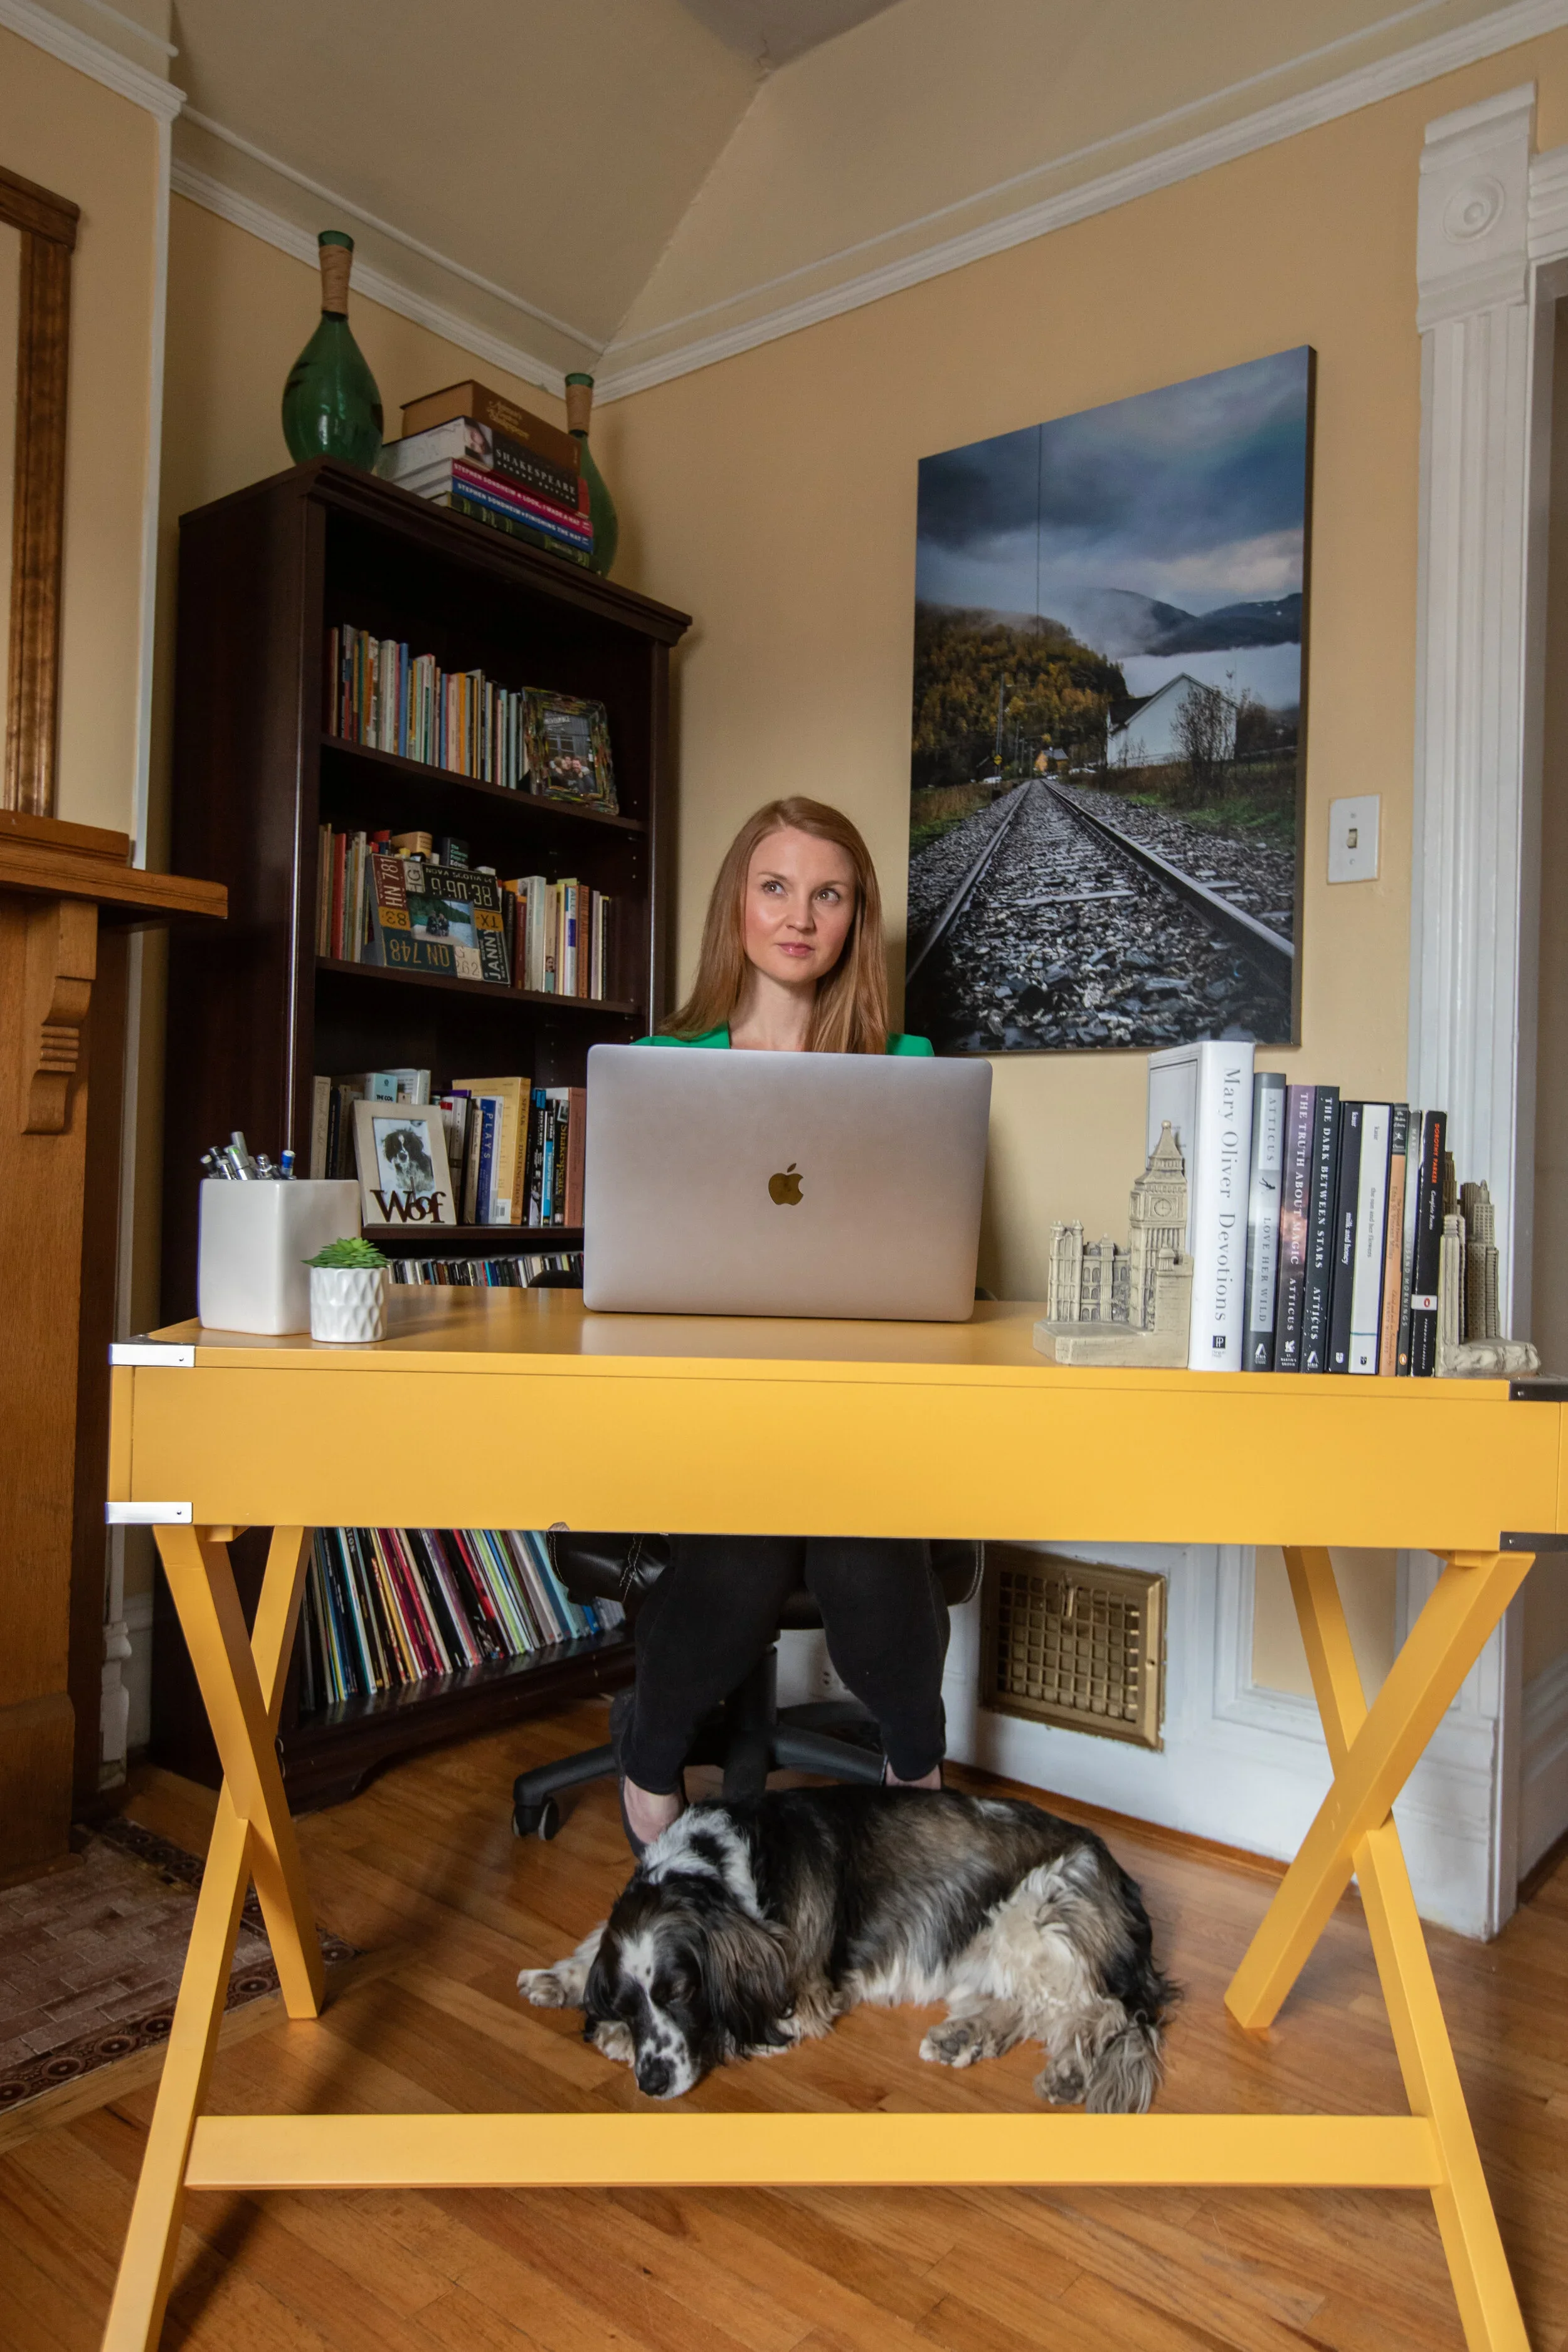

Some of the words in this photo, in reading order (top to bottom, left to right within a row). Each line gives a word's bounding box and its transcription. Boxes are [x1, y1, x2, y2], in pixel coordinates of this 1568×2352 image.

[453, 463, 482, 480] STEPHEN
[495, 448, 576, 495] SHAKESPEARE
[457, 482, 487, 500] STEPHEN
[526, 512, 556, 531] FINISHING
[556, 526, 568, 536] THE
[380, 858, 398, 881] 781
[426, 868, 449, 876] NOVA
[452, 872, 482, 881] SCOTIA
[383, 885, 403, 908] HN
[389, 938, 421, 964] 748
[1217, 1068, 1241, 1121] Mary
[1299, 1093, 1309, 1119] THE
[1323, 1097, 1333, 1123] THE
[484, 1112, 494, 1159] PLAYS
[1266, 1098, 1276, 1161] ATTICUS
[1351, 1111, 1359, 1128] kaur
[1296, 1123, 1308, 1167] TRUTH
[1321, 1127, 1331, 1160] DARK
[514, 1143, 524, 1207] DISTINCTION
[1220, 1131, 1239, 1198] Oliver
[370, 1189, 446, 1223] Woof
[1293, 1171, 1305, 1217] ABOUT
[1317, 1165, 1329, 1226] BETWEEN
[1428, 1190, 1436, 1214] Complete
[1262, 1217, 1271, 1250] LOVE
[1345, 1212, 1353, 1227] milk
[1290, 1222, 1302, 1265] MAGIC
[1315, 1230, 1325, 1268] STARS
[1342, 1243, 1351, 1265] honey
[1215, 1213, 1236, 1321] Devotions
[1261, 1256, 1269, 1282] HER
[1259, 1288, 1268, 1322] WILD
[1286, 1278, 1297, 1331] ATTICUS
[1310, 1286, 1322, 1340] ATTICUS
[347, 1527, 356, 1553] LTON
